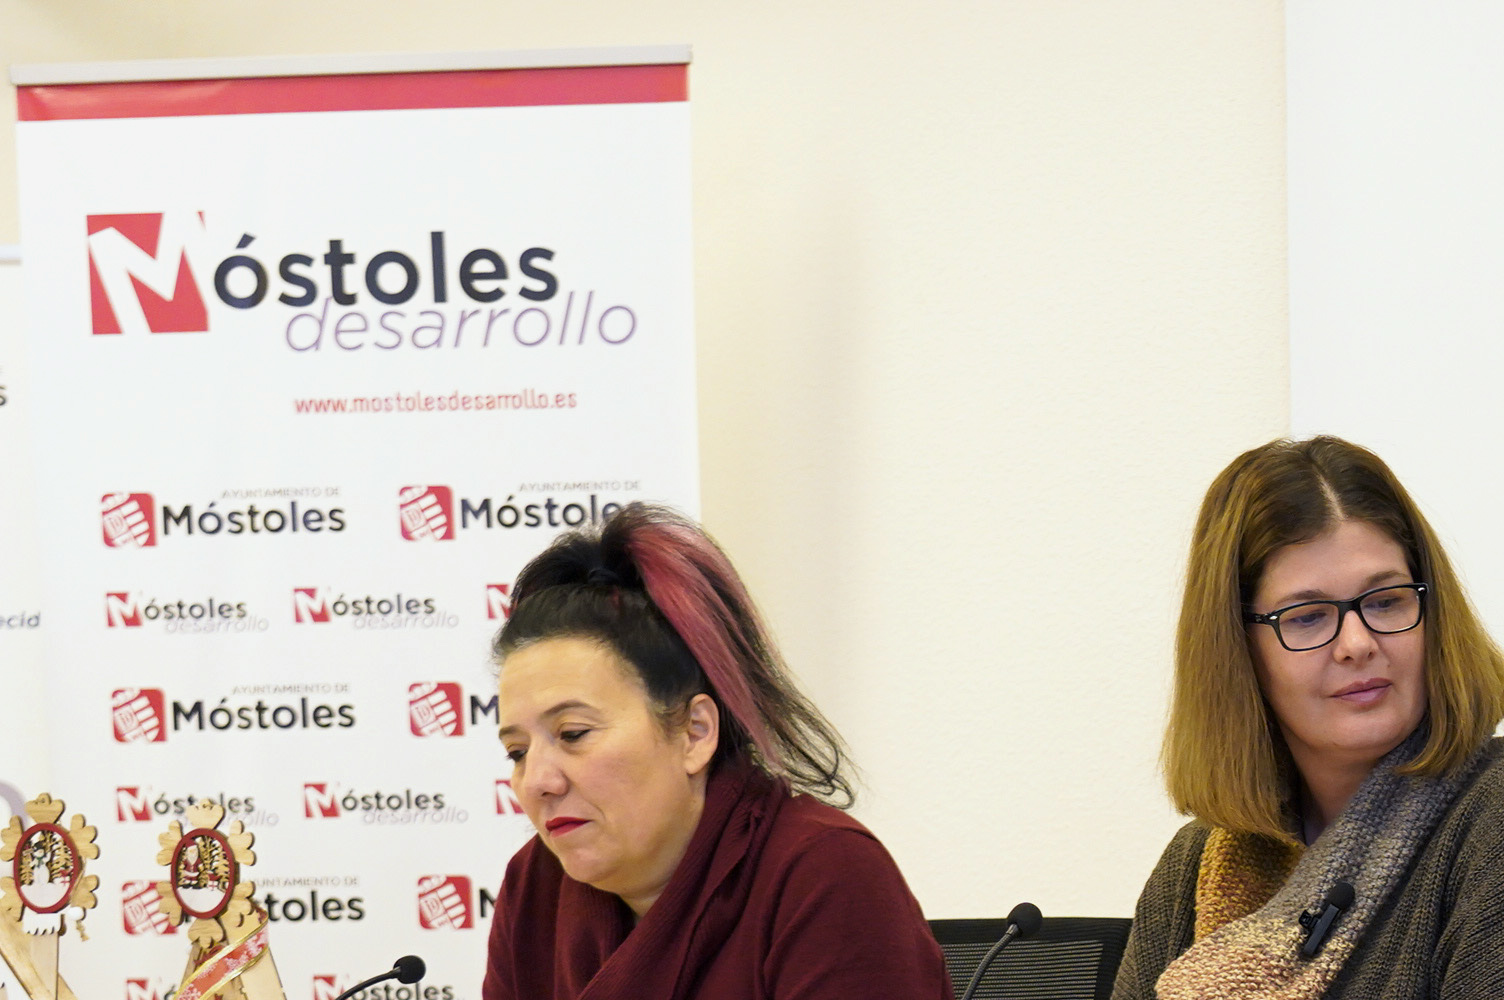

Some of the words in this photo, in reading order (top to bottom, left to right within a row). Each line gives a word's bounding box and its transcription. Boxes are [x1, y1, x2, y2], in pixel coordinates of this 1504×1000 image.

[285, 290, 638, 353] desarrollo
[294, 388, 578, 414] www.mostolesdesarrollo.es
[162, 500, 346, 535] Móstoles
[460, 494, 623, 529] Móstole
[164, 615, 270, 634] desarrollo
[353, 611, 460, 630] desarrollo
[172, 697, 356, 731] Móstoles
[362, 807, 470, 825] desarrollo
